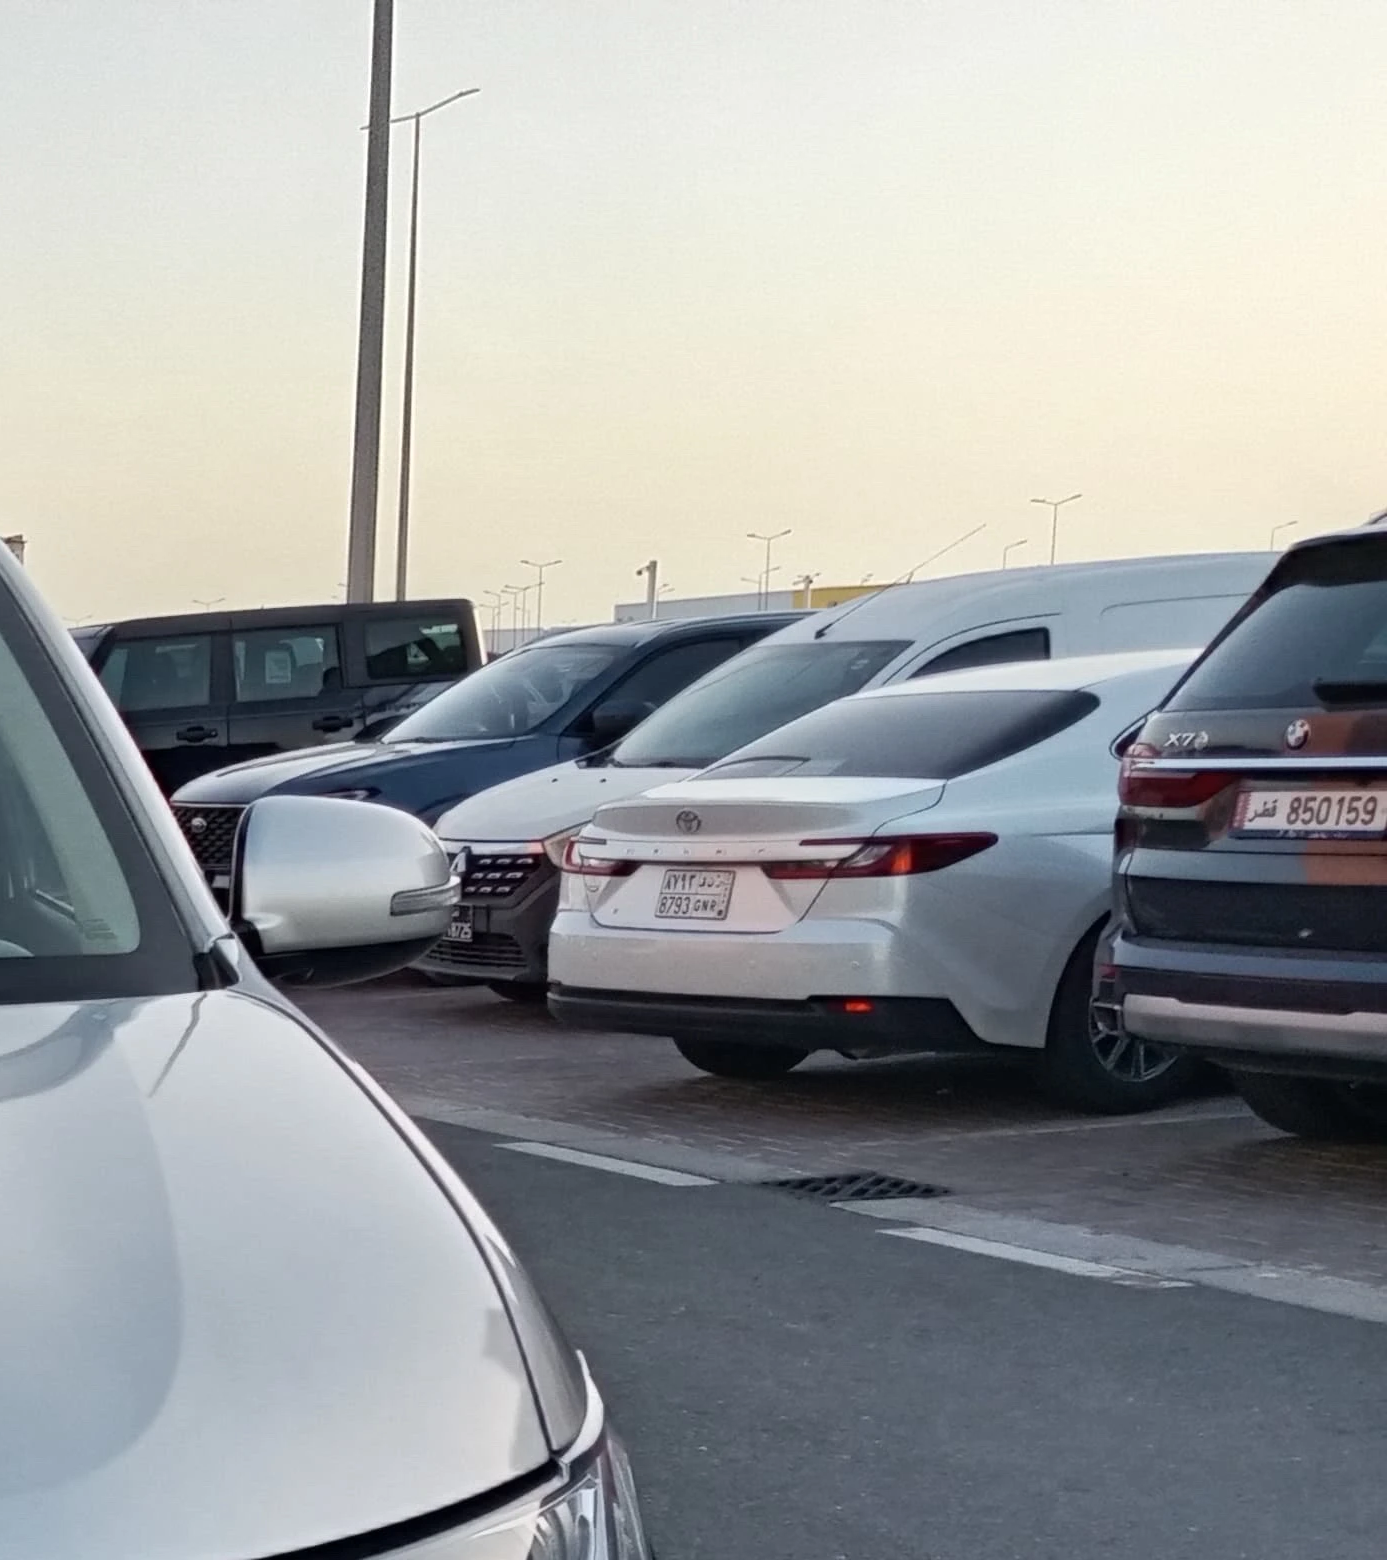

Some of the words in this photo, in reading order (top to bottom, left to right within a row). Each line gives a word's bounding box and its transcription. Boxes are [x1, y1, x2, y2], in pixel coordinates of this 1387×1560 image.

[1163, 732, 1196, 747] X7
[1248, 798, 1279, 823] قطر
[1286, 796, 1378, 826] 850159
[658, 896, 691, 915] 8793
